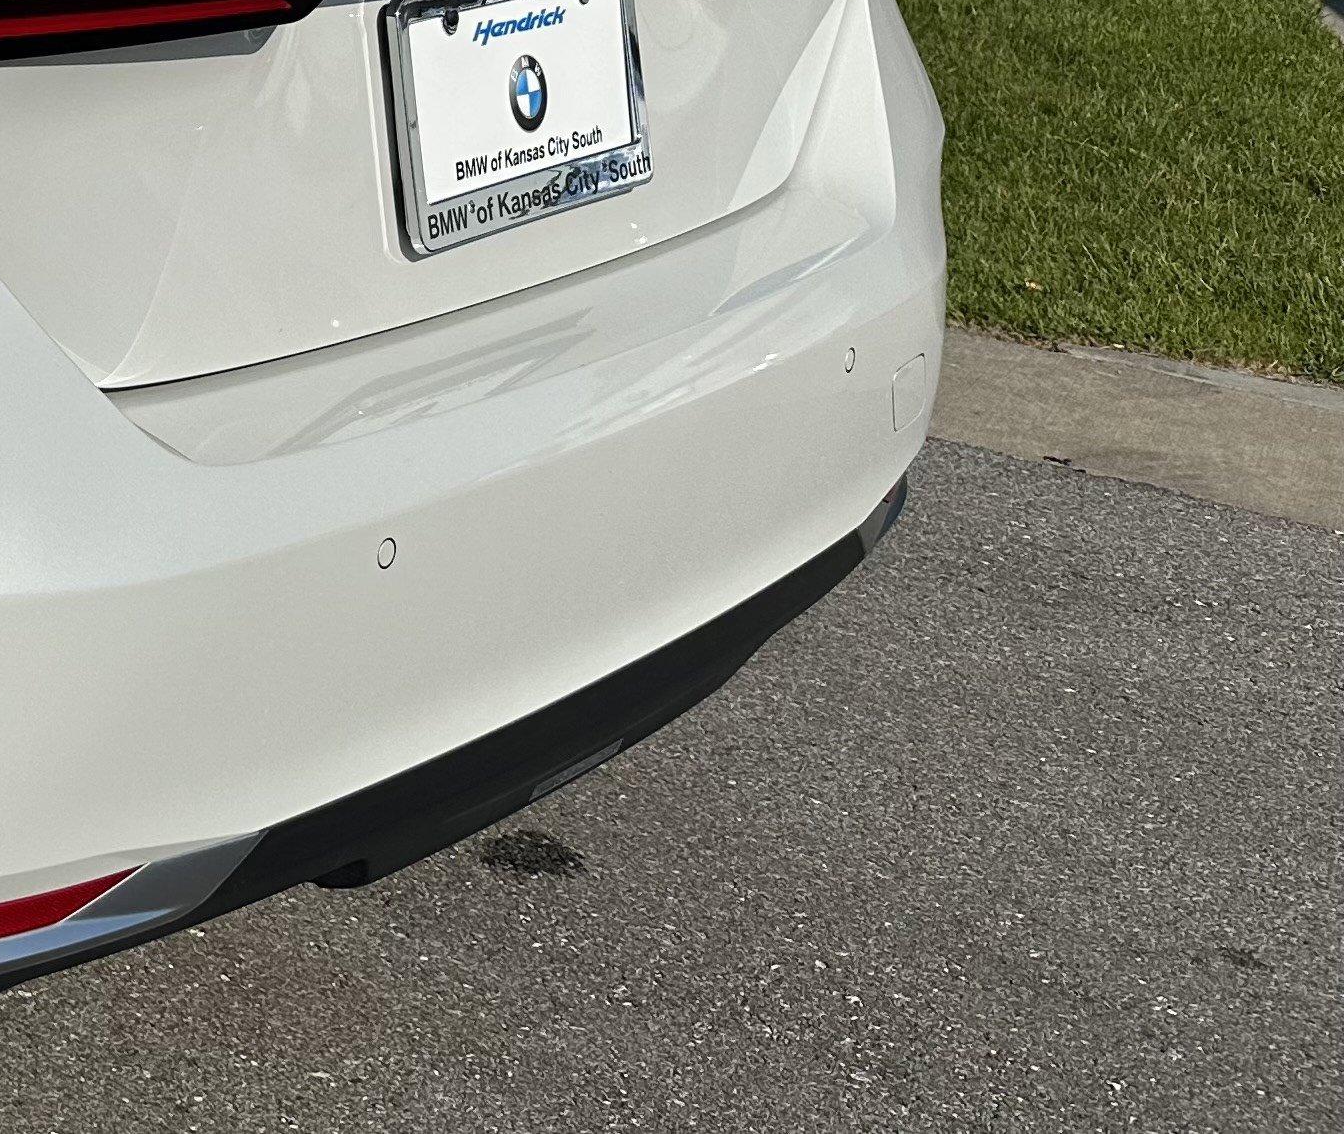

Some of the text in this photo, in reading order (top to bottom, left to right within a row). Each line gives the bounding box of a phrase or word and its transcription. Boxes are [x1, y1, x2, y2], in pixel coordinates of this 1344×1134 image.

[472, 6, 566, 46] Hendrick
[510, 56, 542, 83] BMW
[456, 125, 603, 181] BMW of Kansas City South
[428, 152, 652, 239] BMW of Kansas City South
